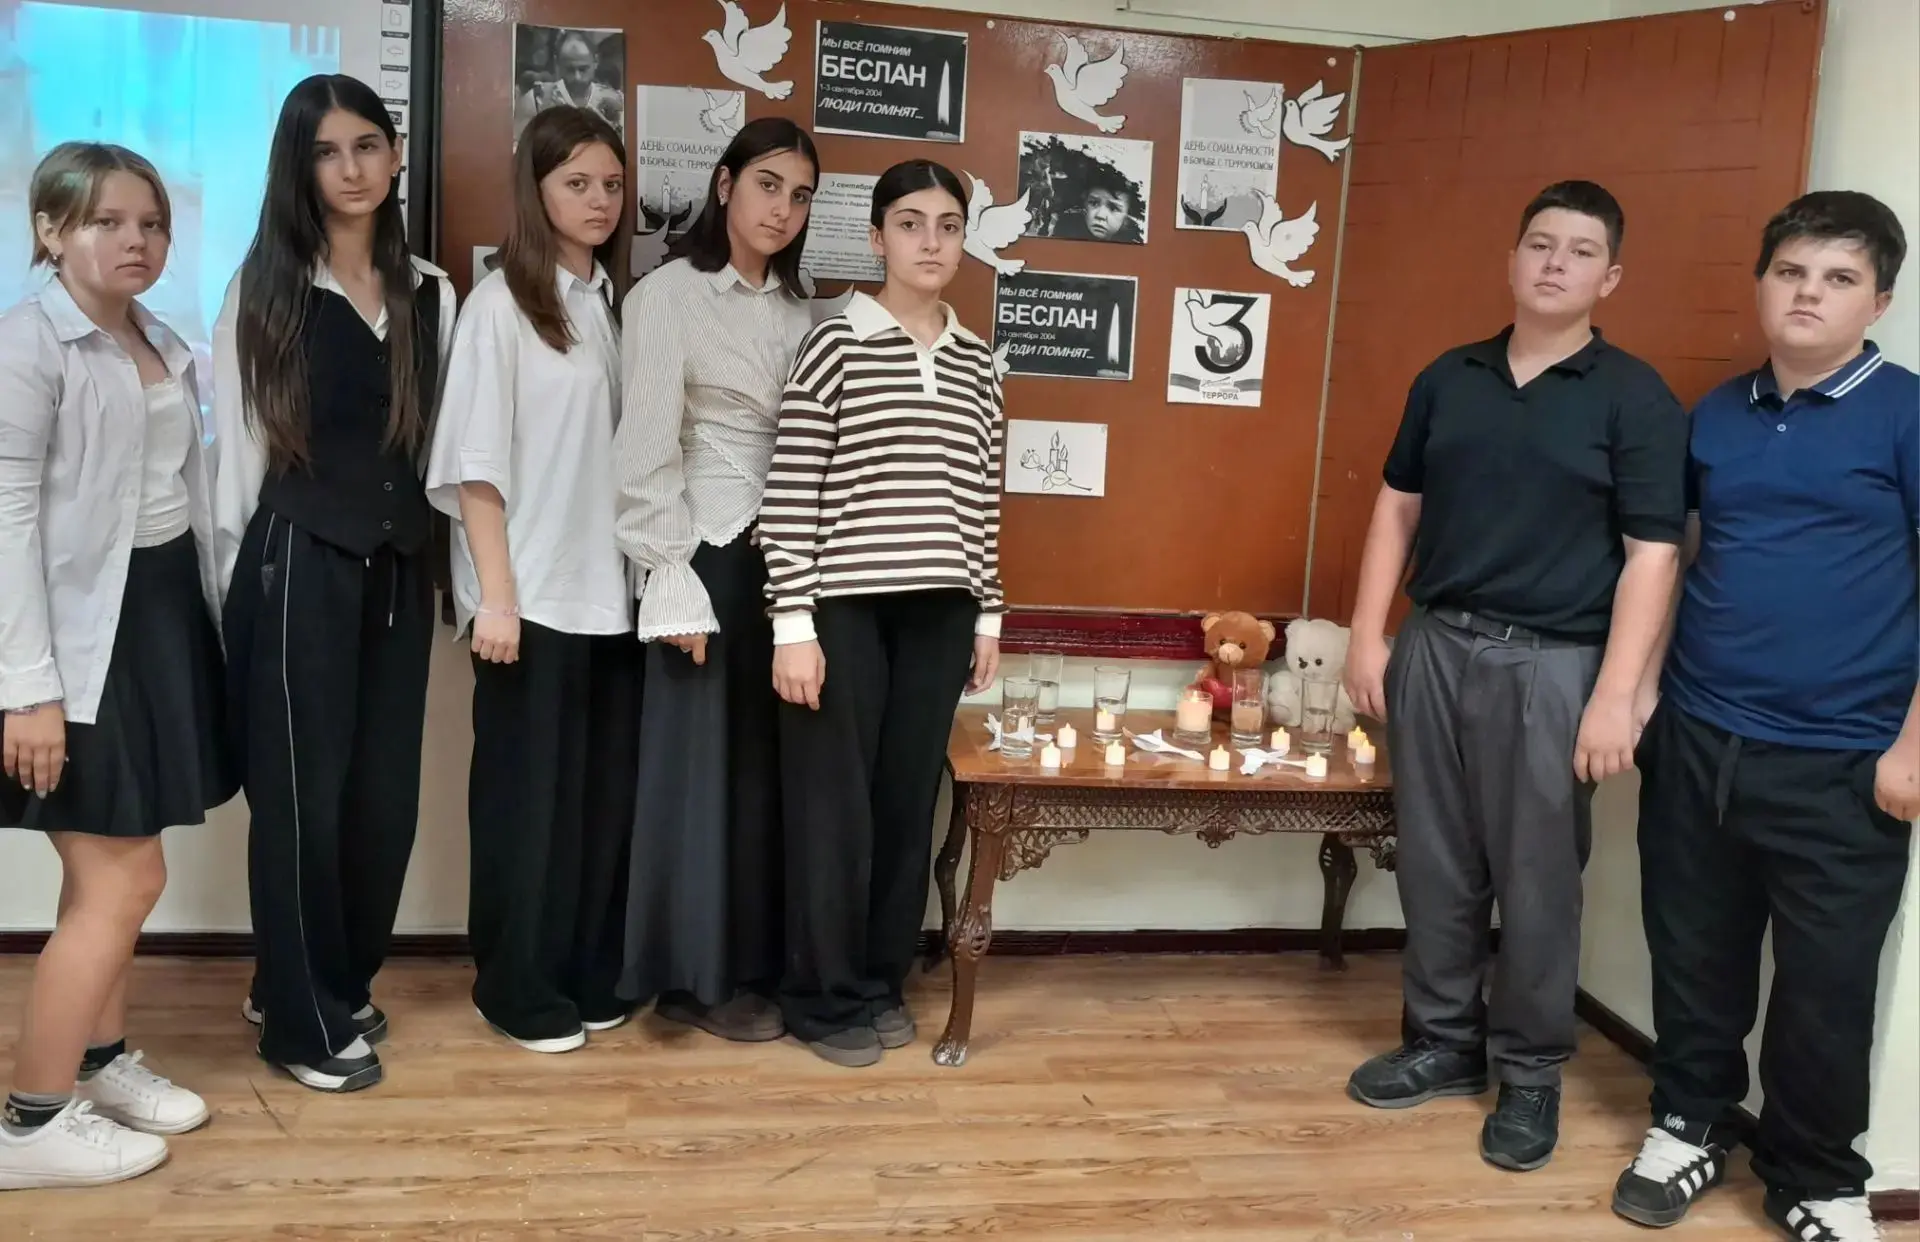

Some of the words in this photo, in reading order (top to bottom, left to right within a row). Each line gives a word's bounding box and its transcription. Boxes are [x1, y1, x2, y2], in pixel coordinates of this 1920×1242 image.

[822, 37, 841, 48] МЫ
[843, 40, 864, 51] ВСЁ
[865, 44, 912, 57] ПОМНИМ
[821, 54, 926, 88] БЕСЛАН
[820, 83, 830, 91] 1-3
[831, 86, 865, 96] сентября
[865, 88, 883, 97] 2004
[818, 97, 862, 113] ЛЮДИ
[640, 140, 665, 152] ДЕНЬ
[1184, 140, 1206, 152] ДЕНЬ
[1207, 142, 1275, 157] СОЛИДАРНОСТИ
[646, 157, 677, 168] БОРЬБЕ
[1189, 156, 1216, 166] БОРЬБЕ
[1224, 159, 1274, 171] ТЕРРОРИЗМОМ
[999, 286, 1017, 297] МЫ
[1018, 287, 1038, 298] ВСЁ
[1039, 290, 1084, 301] ПОМНИМ
[998, 302, 1098, 330] БЕСЛАН
[997, 329, 1007, 338] 1-3
[1007, 331, 1039, 340] сентября
[1040, 332, 1056, 340] 2004
[1202, 391, 1239, 400] ТЕРРОРА
